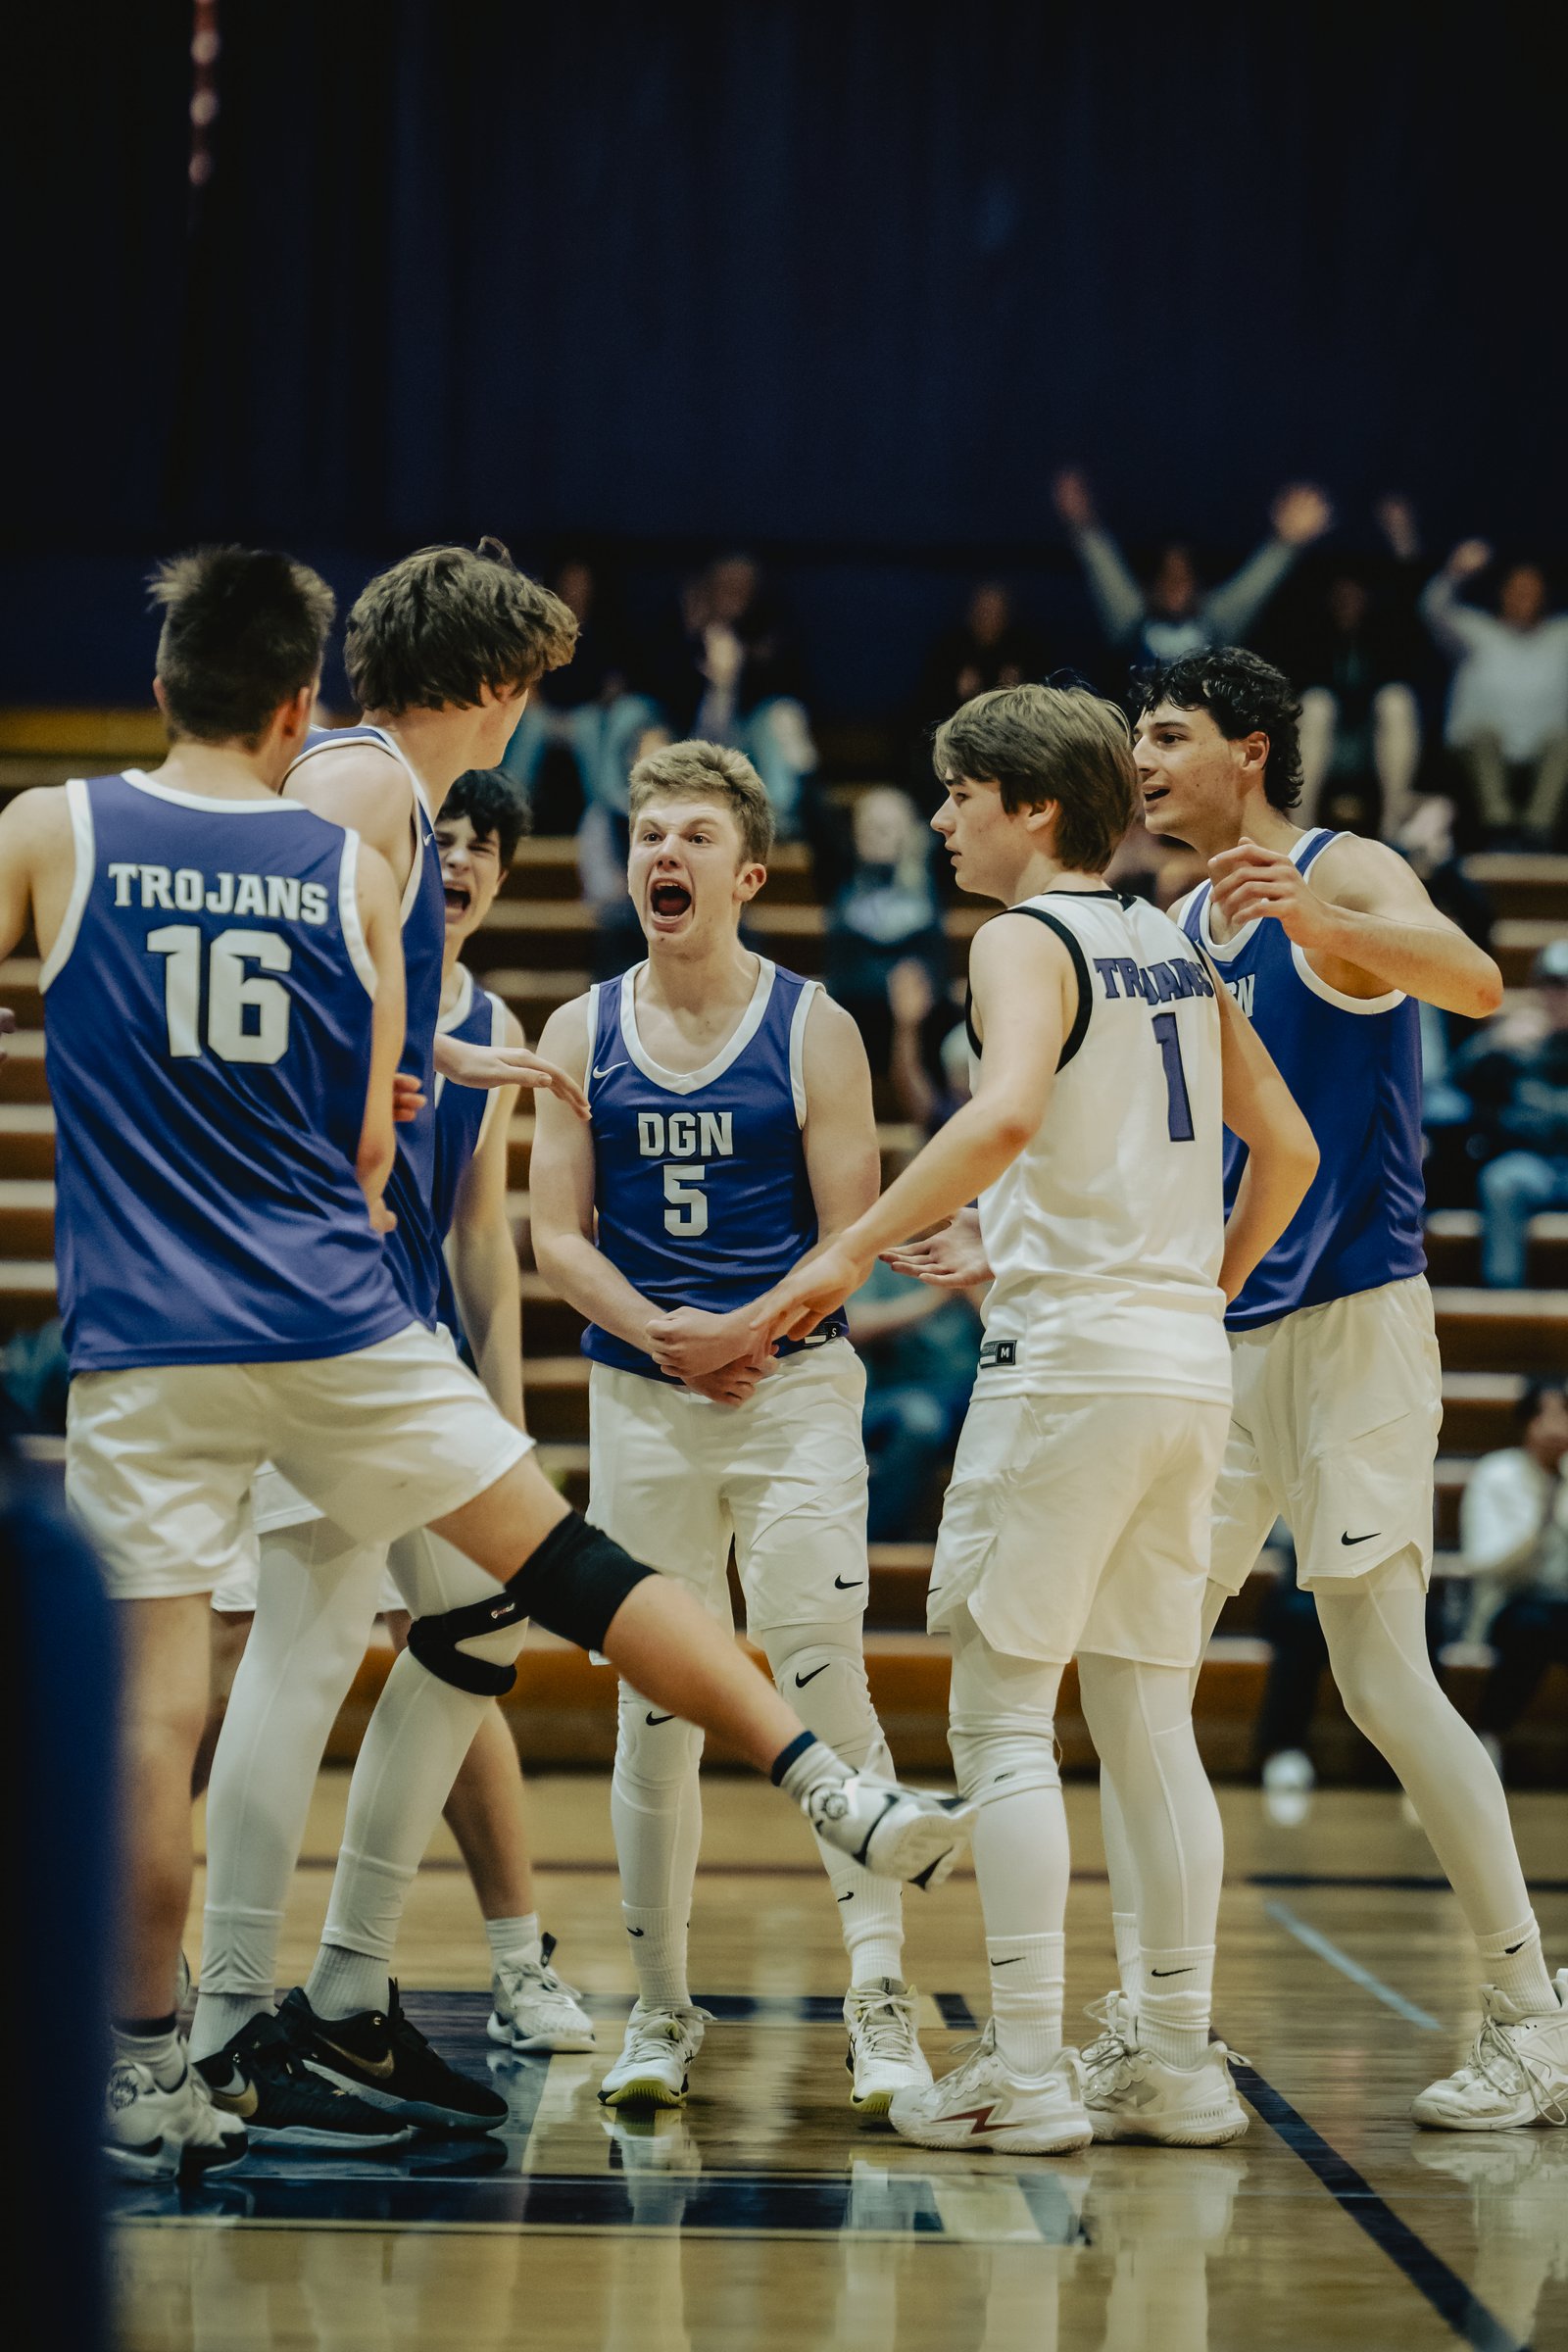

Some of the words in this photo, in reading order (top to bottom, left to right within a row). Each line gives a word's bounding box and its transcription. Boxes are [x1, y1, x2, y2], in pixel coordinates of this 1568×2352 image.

[108, 862, 328, 925] TROJANS
[147, 924, 292, 1064] 16
[1152, 1012, 1195, 1142] 1
[638, 1112, 733, 1156] DGN
[663, 1164, 709, 1236] 5
[830, 1327, 838, 1338] S
[1001, 1347, 1010, 1359] M
